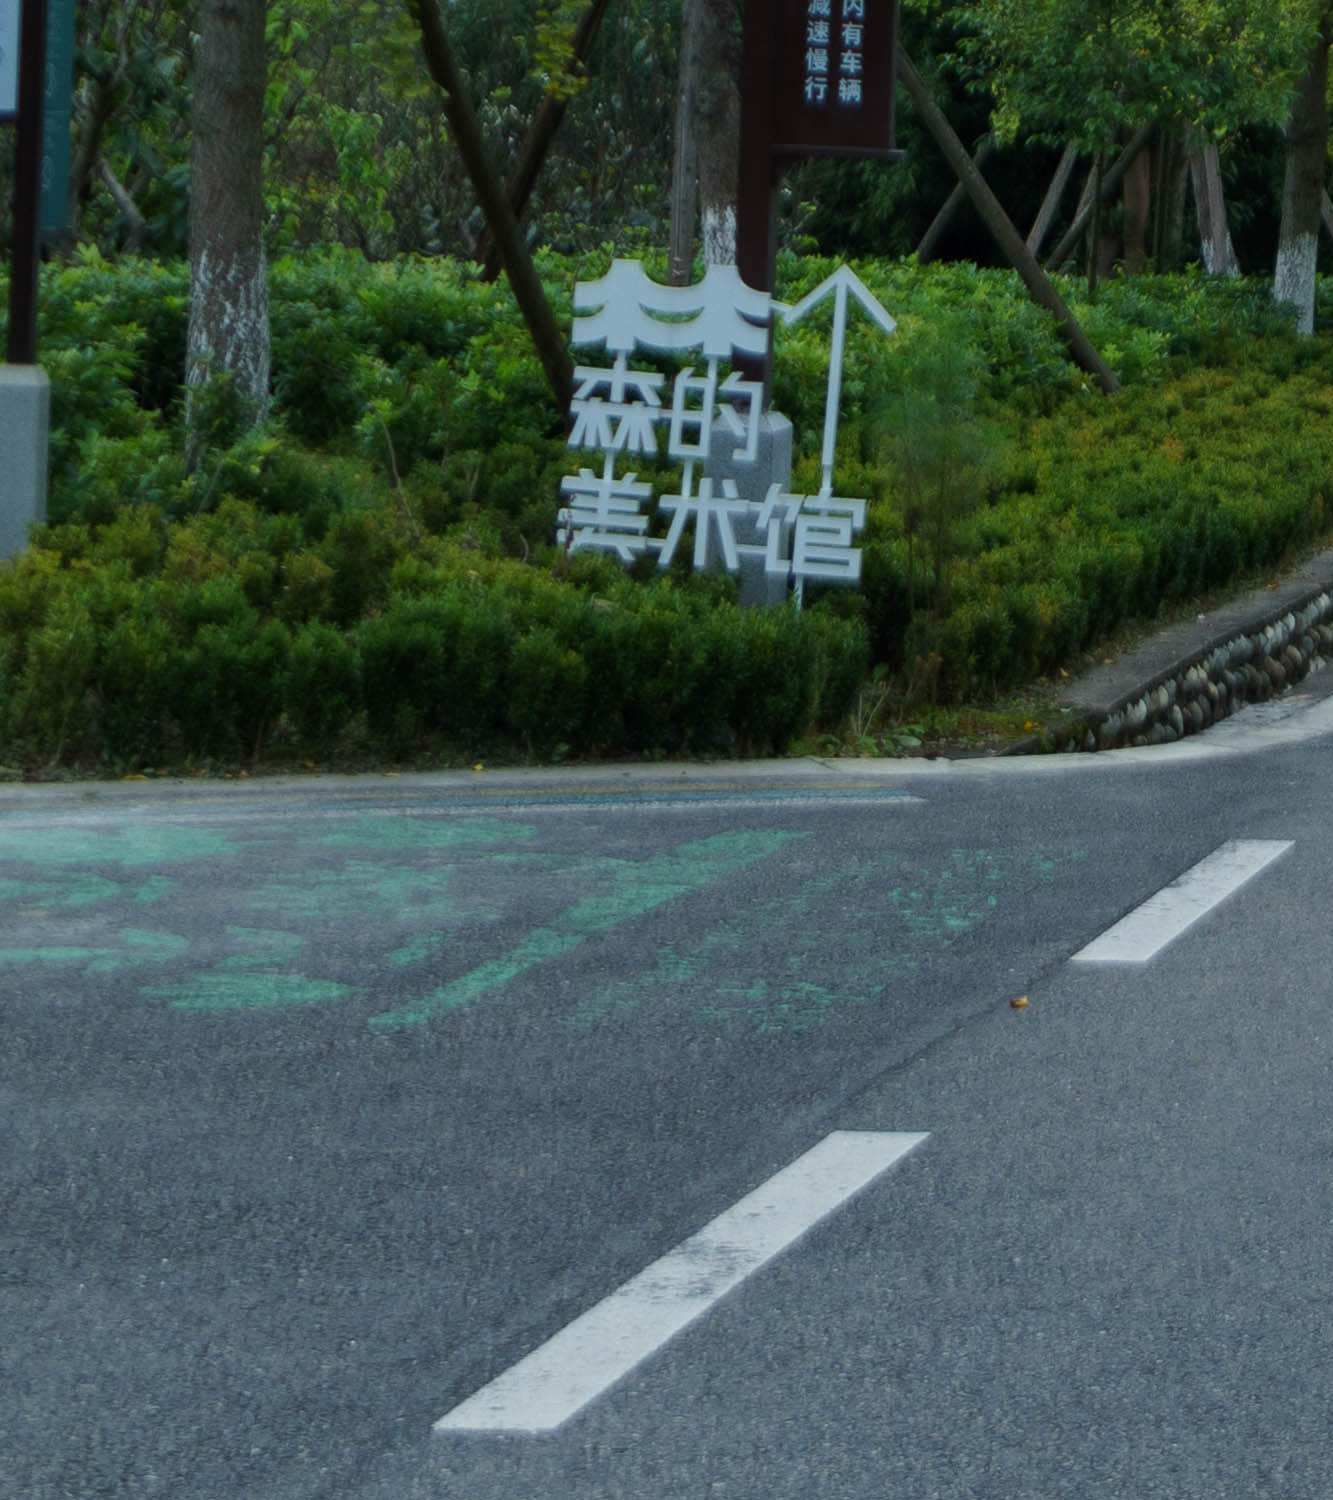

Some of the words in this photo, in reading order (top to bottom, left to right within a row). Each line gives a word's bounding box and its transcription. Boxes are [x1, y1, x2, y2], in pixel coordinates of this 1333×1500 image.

[567, 367, 764, 462] 森的
[555, 468, 868, 579] 美术馆
